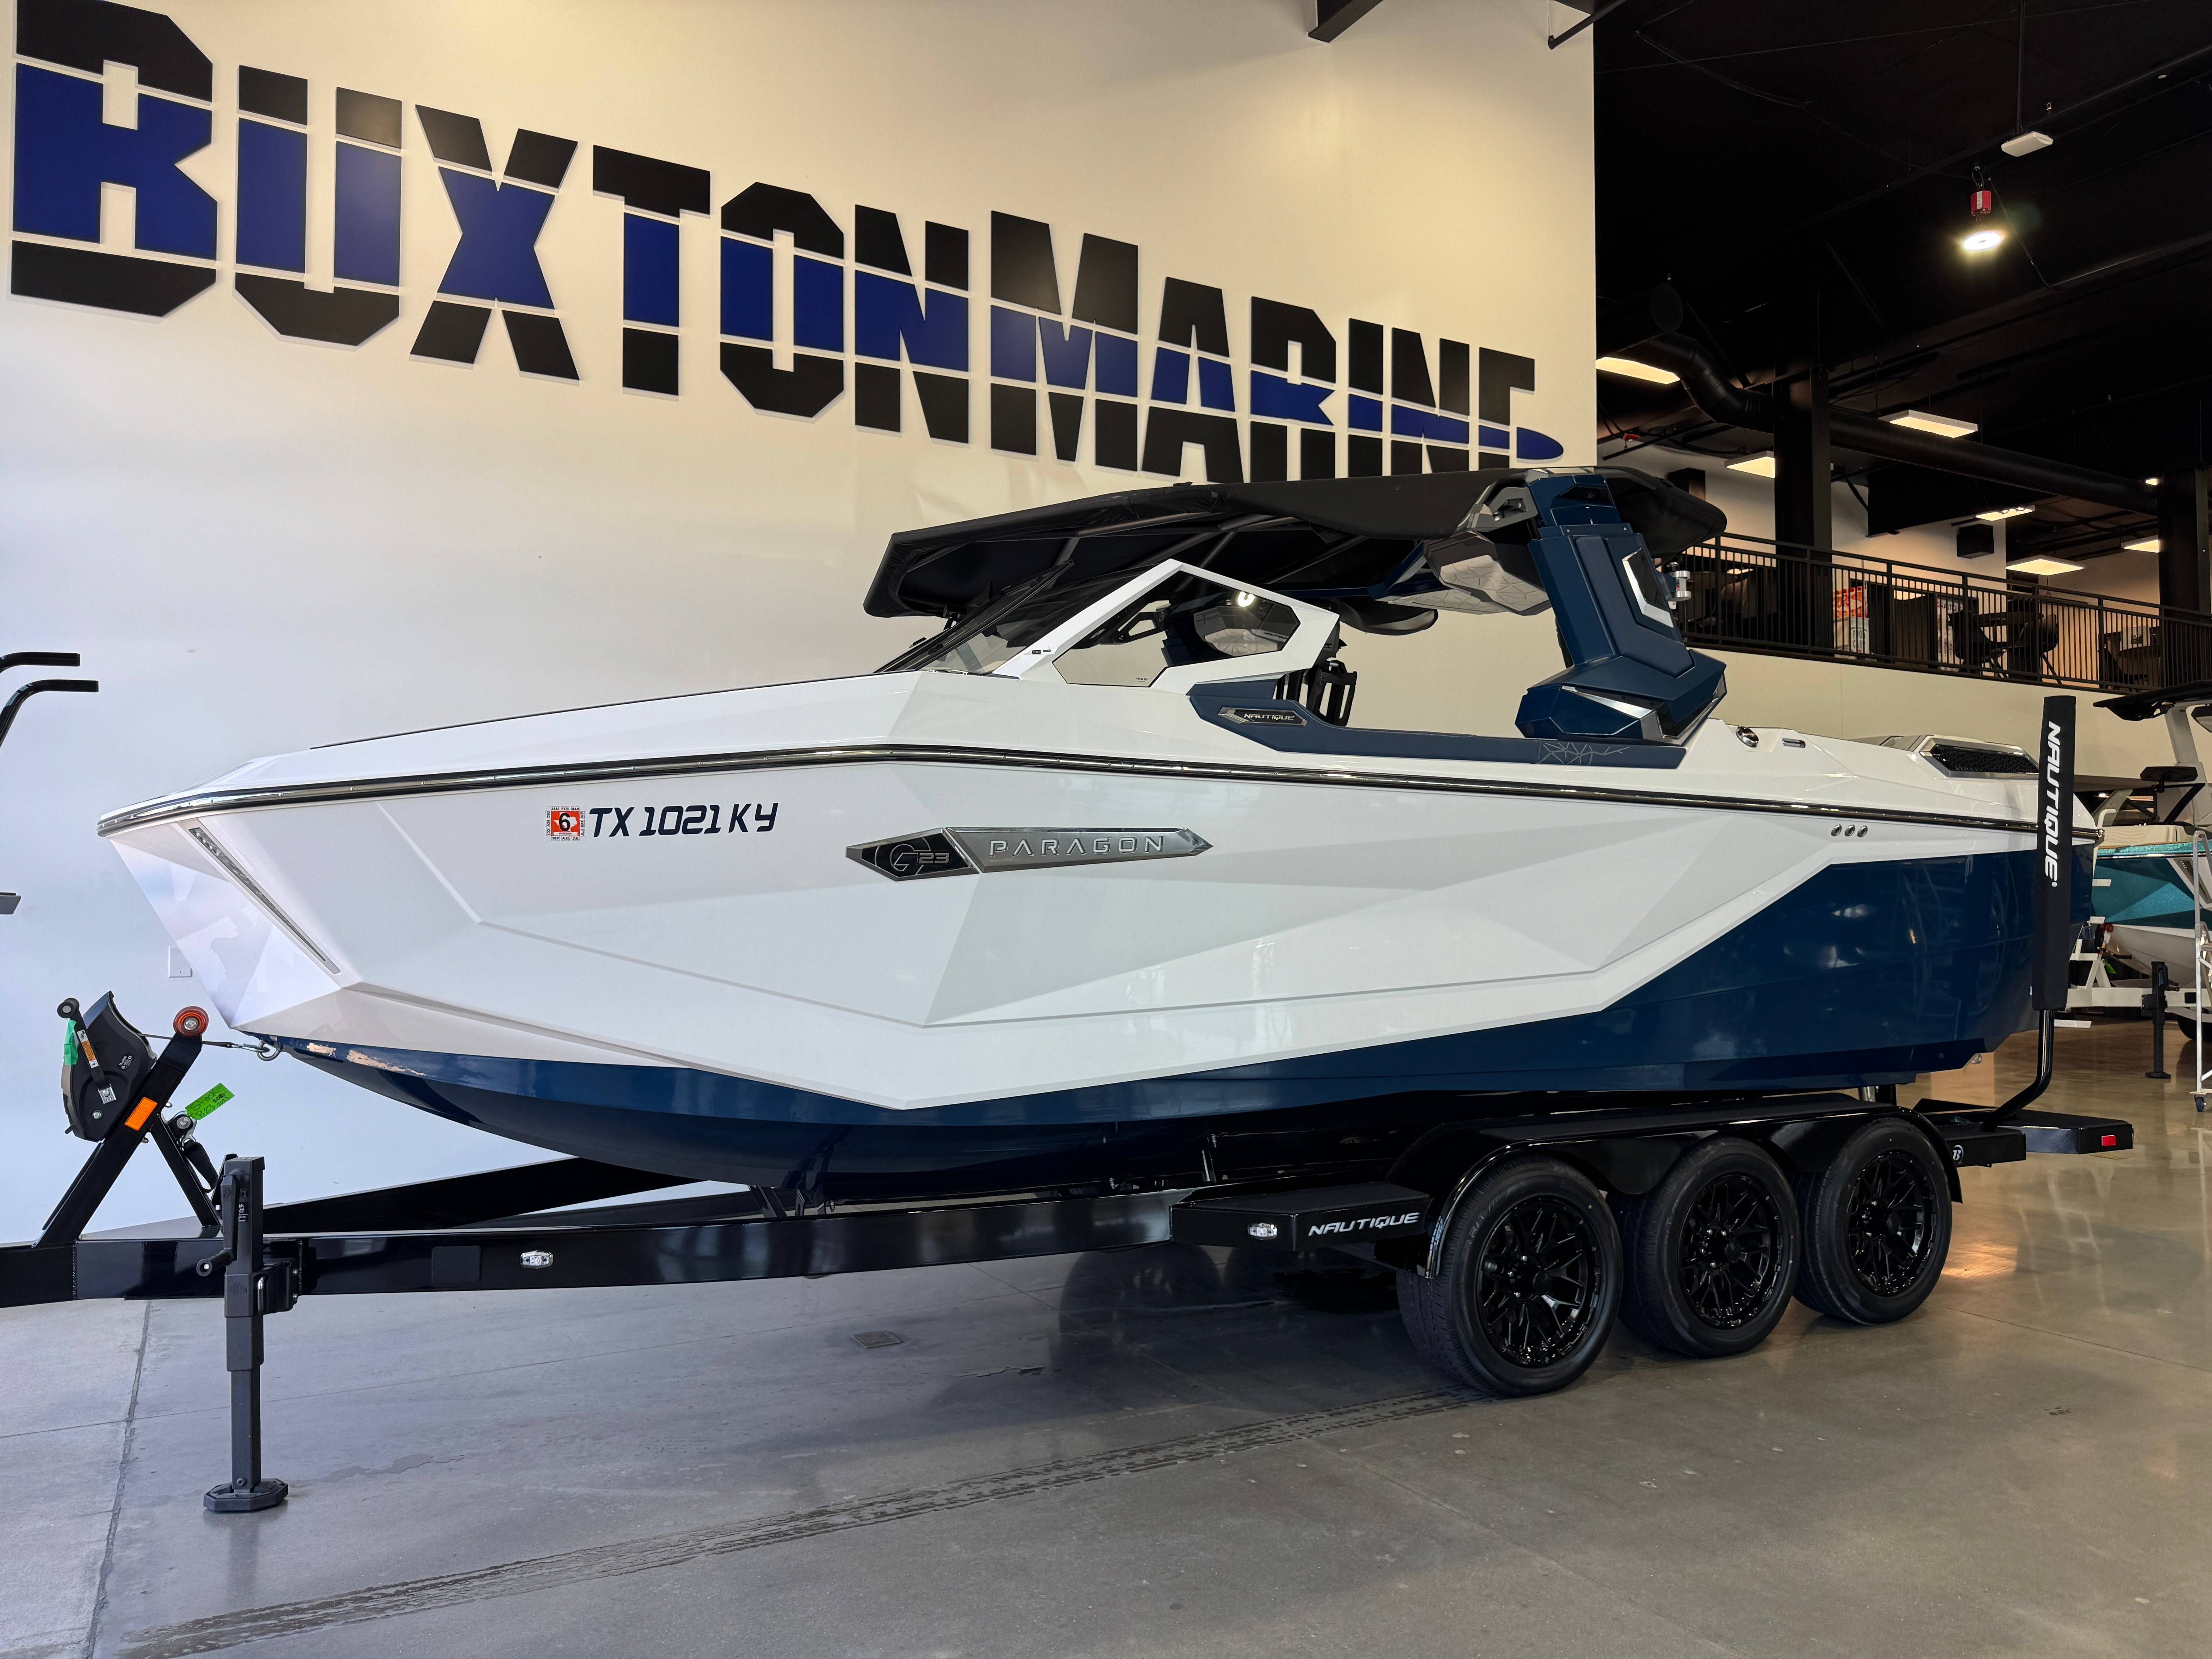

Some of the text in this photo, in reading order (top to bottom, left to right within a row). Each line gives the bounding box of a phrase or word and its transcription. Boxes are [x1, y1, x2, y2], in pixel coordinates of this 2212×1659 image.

[2044, 721, 2061, 882] NAUTIQUE
[559, 812, 570, 831] 6
[589, 802, 779, 837] TX 1021 KY
[990, 835, 1164, 857] PARAGON
[1309, 1212, 1420, 1236] NAUTIQUE
